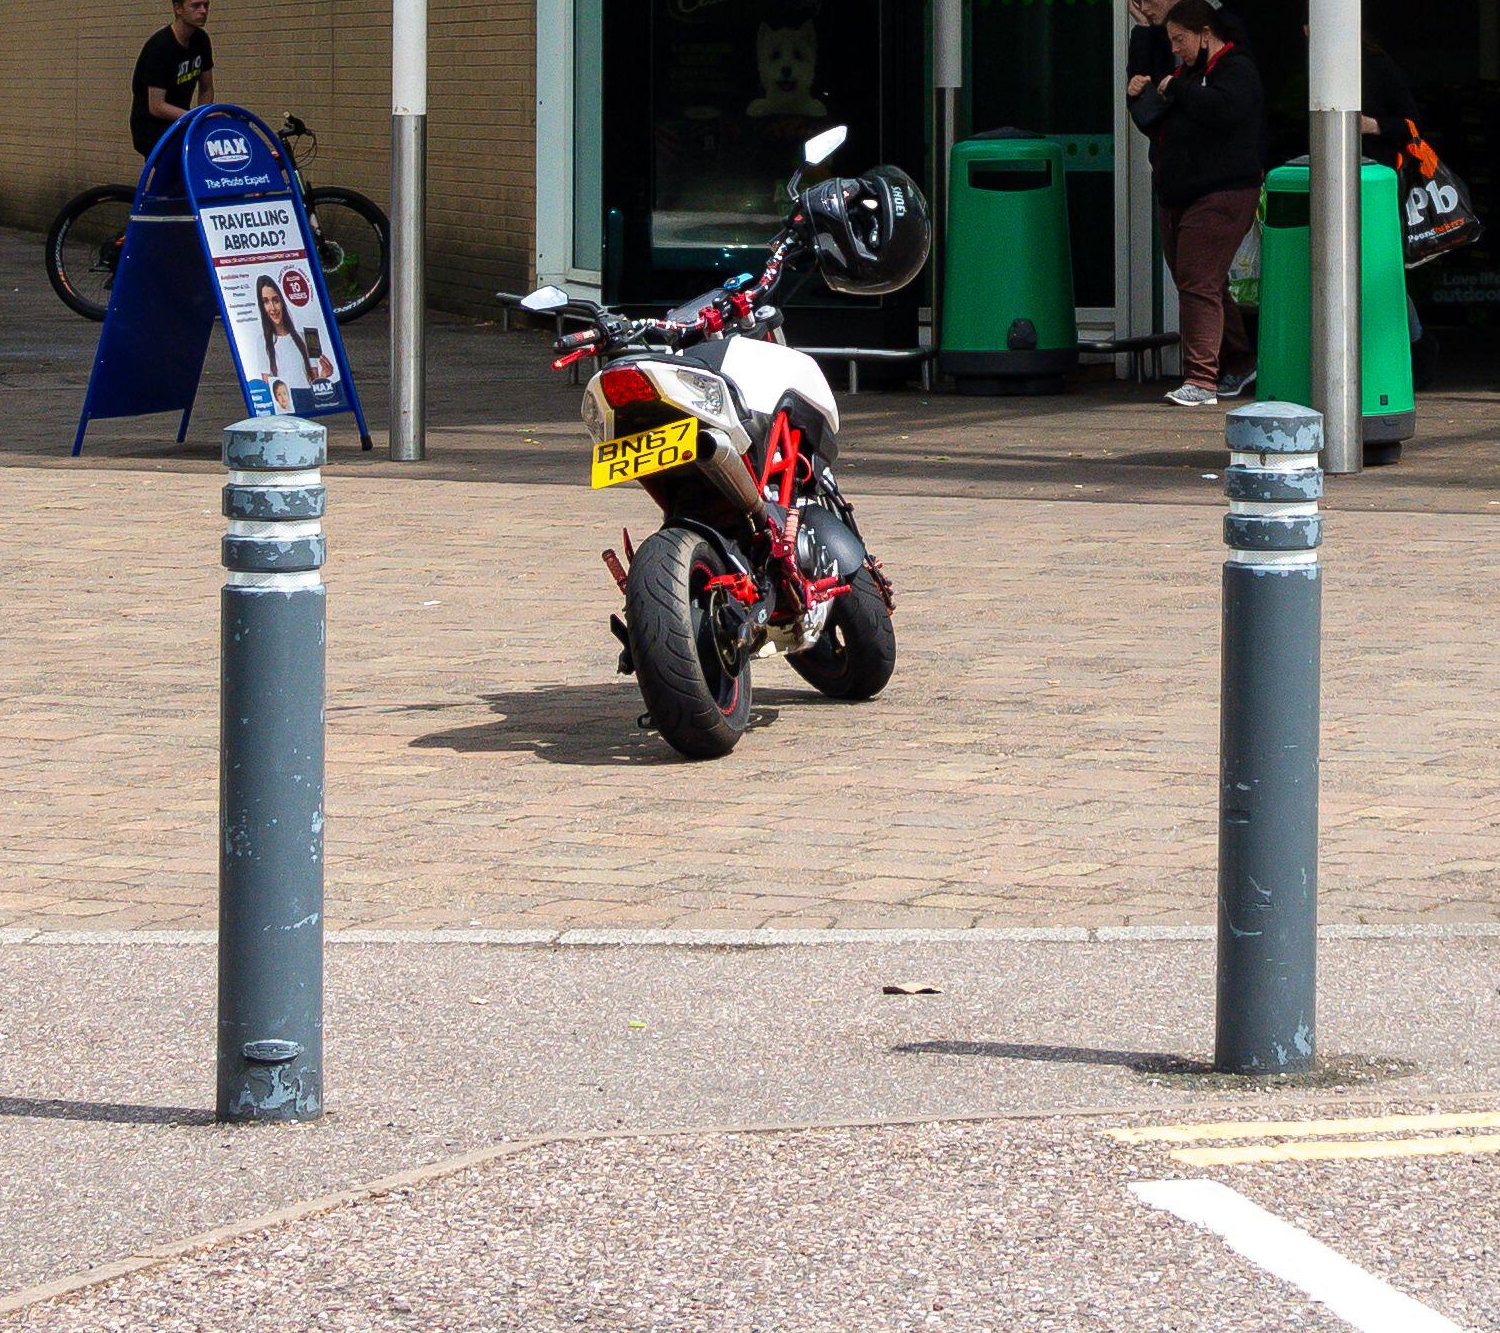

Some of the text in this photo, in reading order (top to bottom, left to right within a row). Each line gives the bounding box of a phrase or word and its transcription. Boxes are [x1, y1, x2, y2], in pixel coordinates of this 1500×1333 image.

[206, 137, 248, 157] MAX
[205, 179, 220, 189] The
[244, 174, 270, 186] Expert
[891, 185, 906, 217] SHOEI
[1406, 180, 1458, 226] Pb
[209, 209, 289, 231] TRAVELLING
[224, 229, 286, 250] ABROAD?
[598, 422, 691, 463] BN67
[609, 446, 678, 480] RFO
